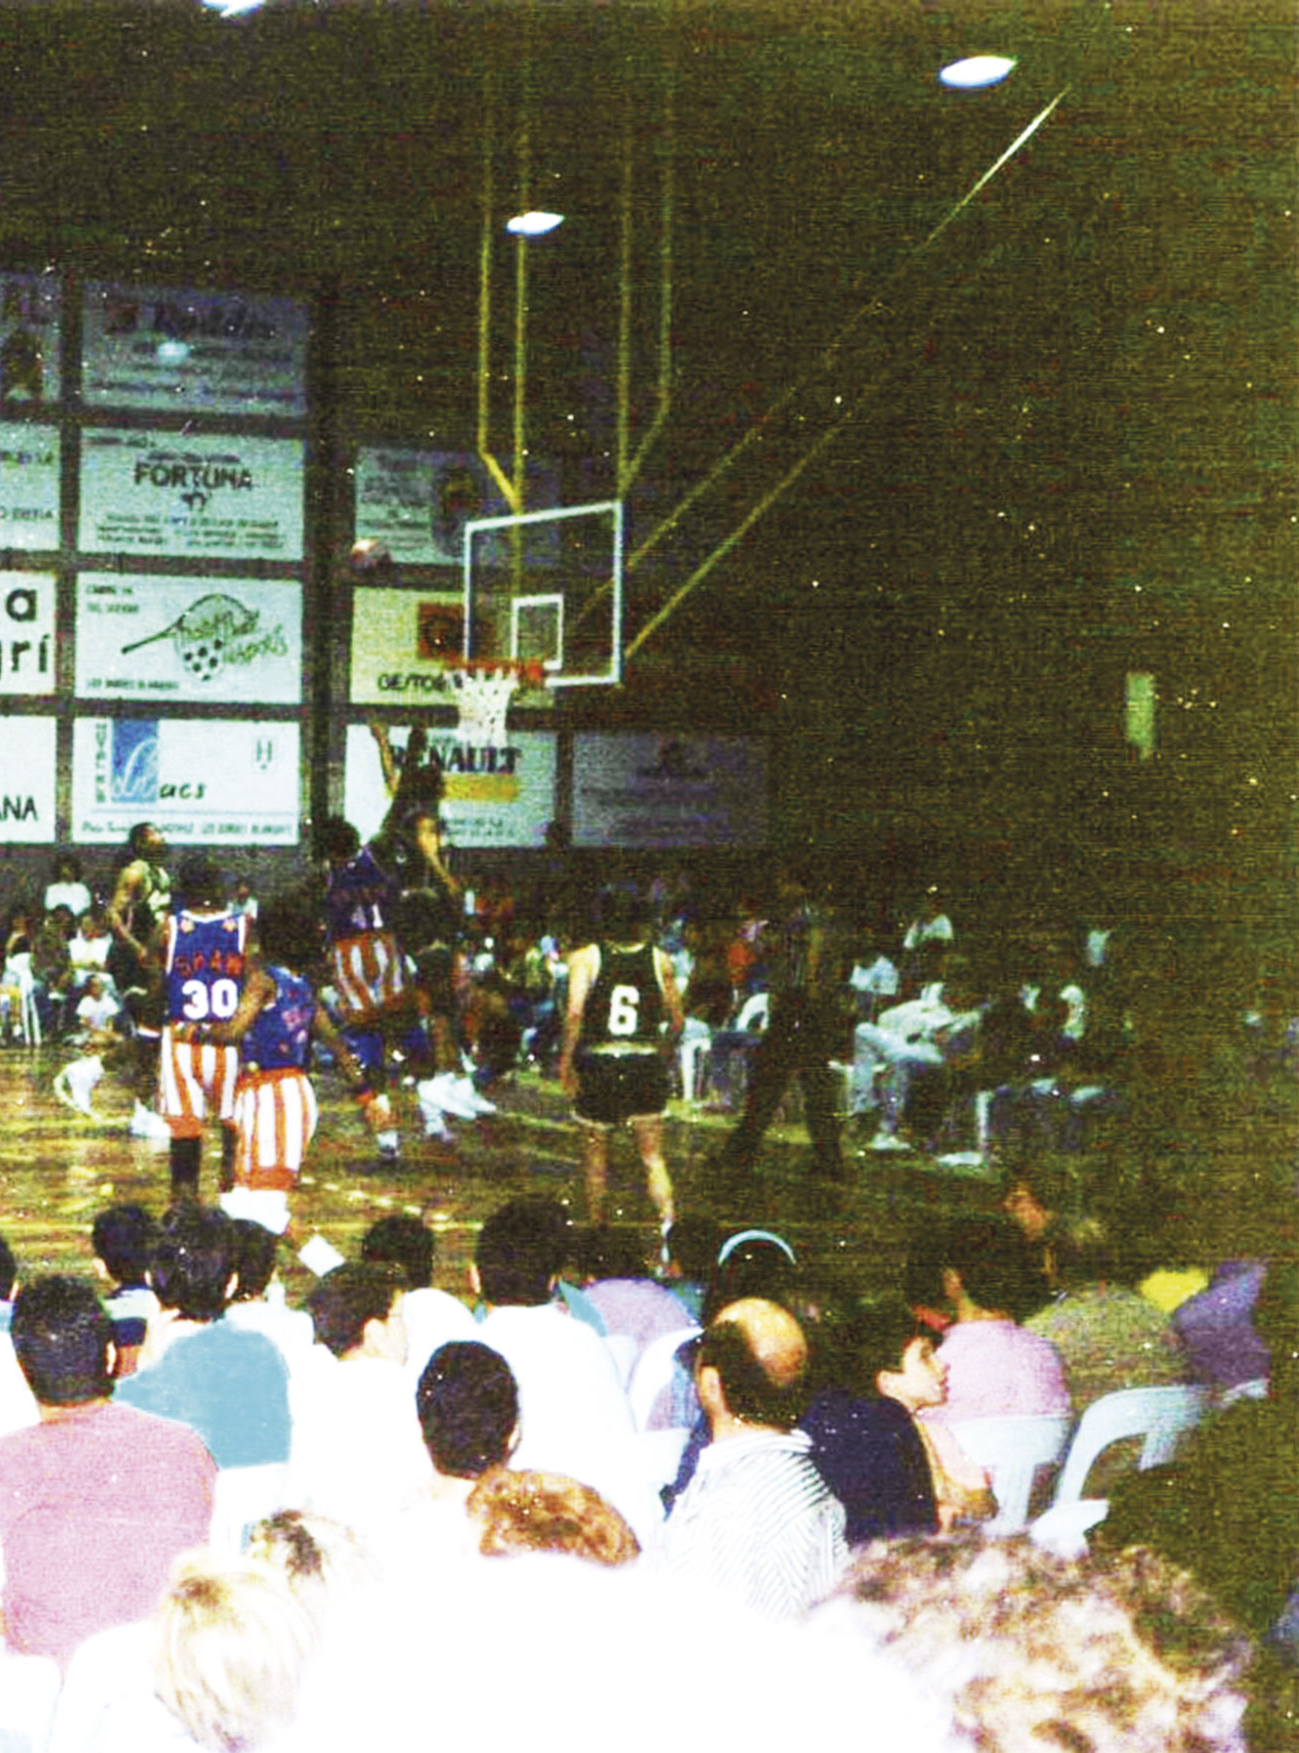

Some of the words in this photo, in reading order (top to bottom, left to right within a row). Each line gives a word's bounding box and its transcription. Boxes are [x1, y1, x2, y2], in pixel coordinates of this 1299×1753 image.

[135, 461, 253, 490] FORTUNA
[181, 979, 238, 1020] 30
[608, 985, 640, 1036] 6
